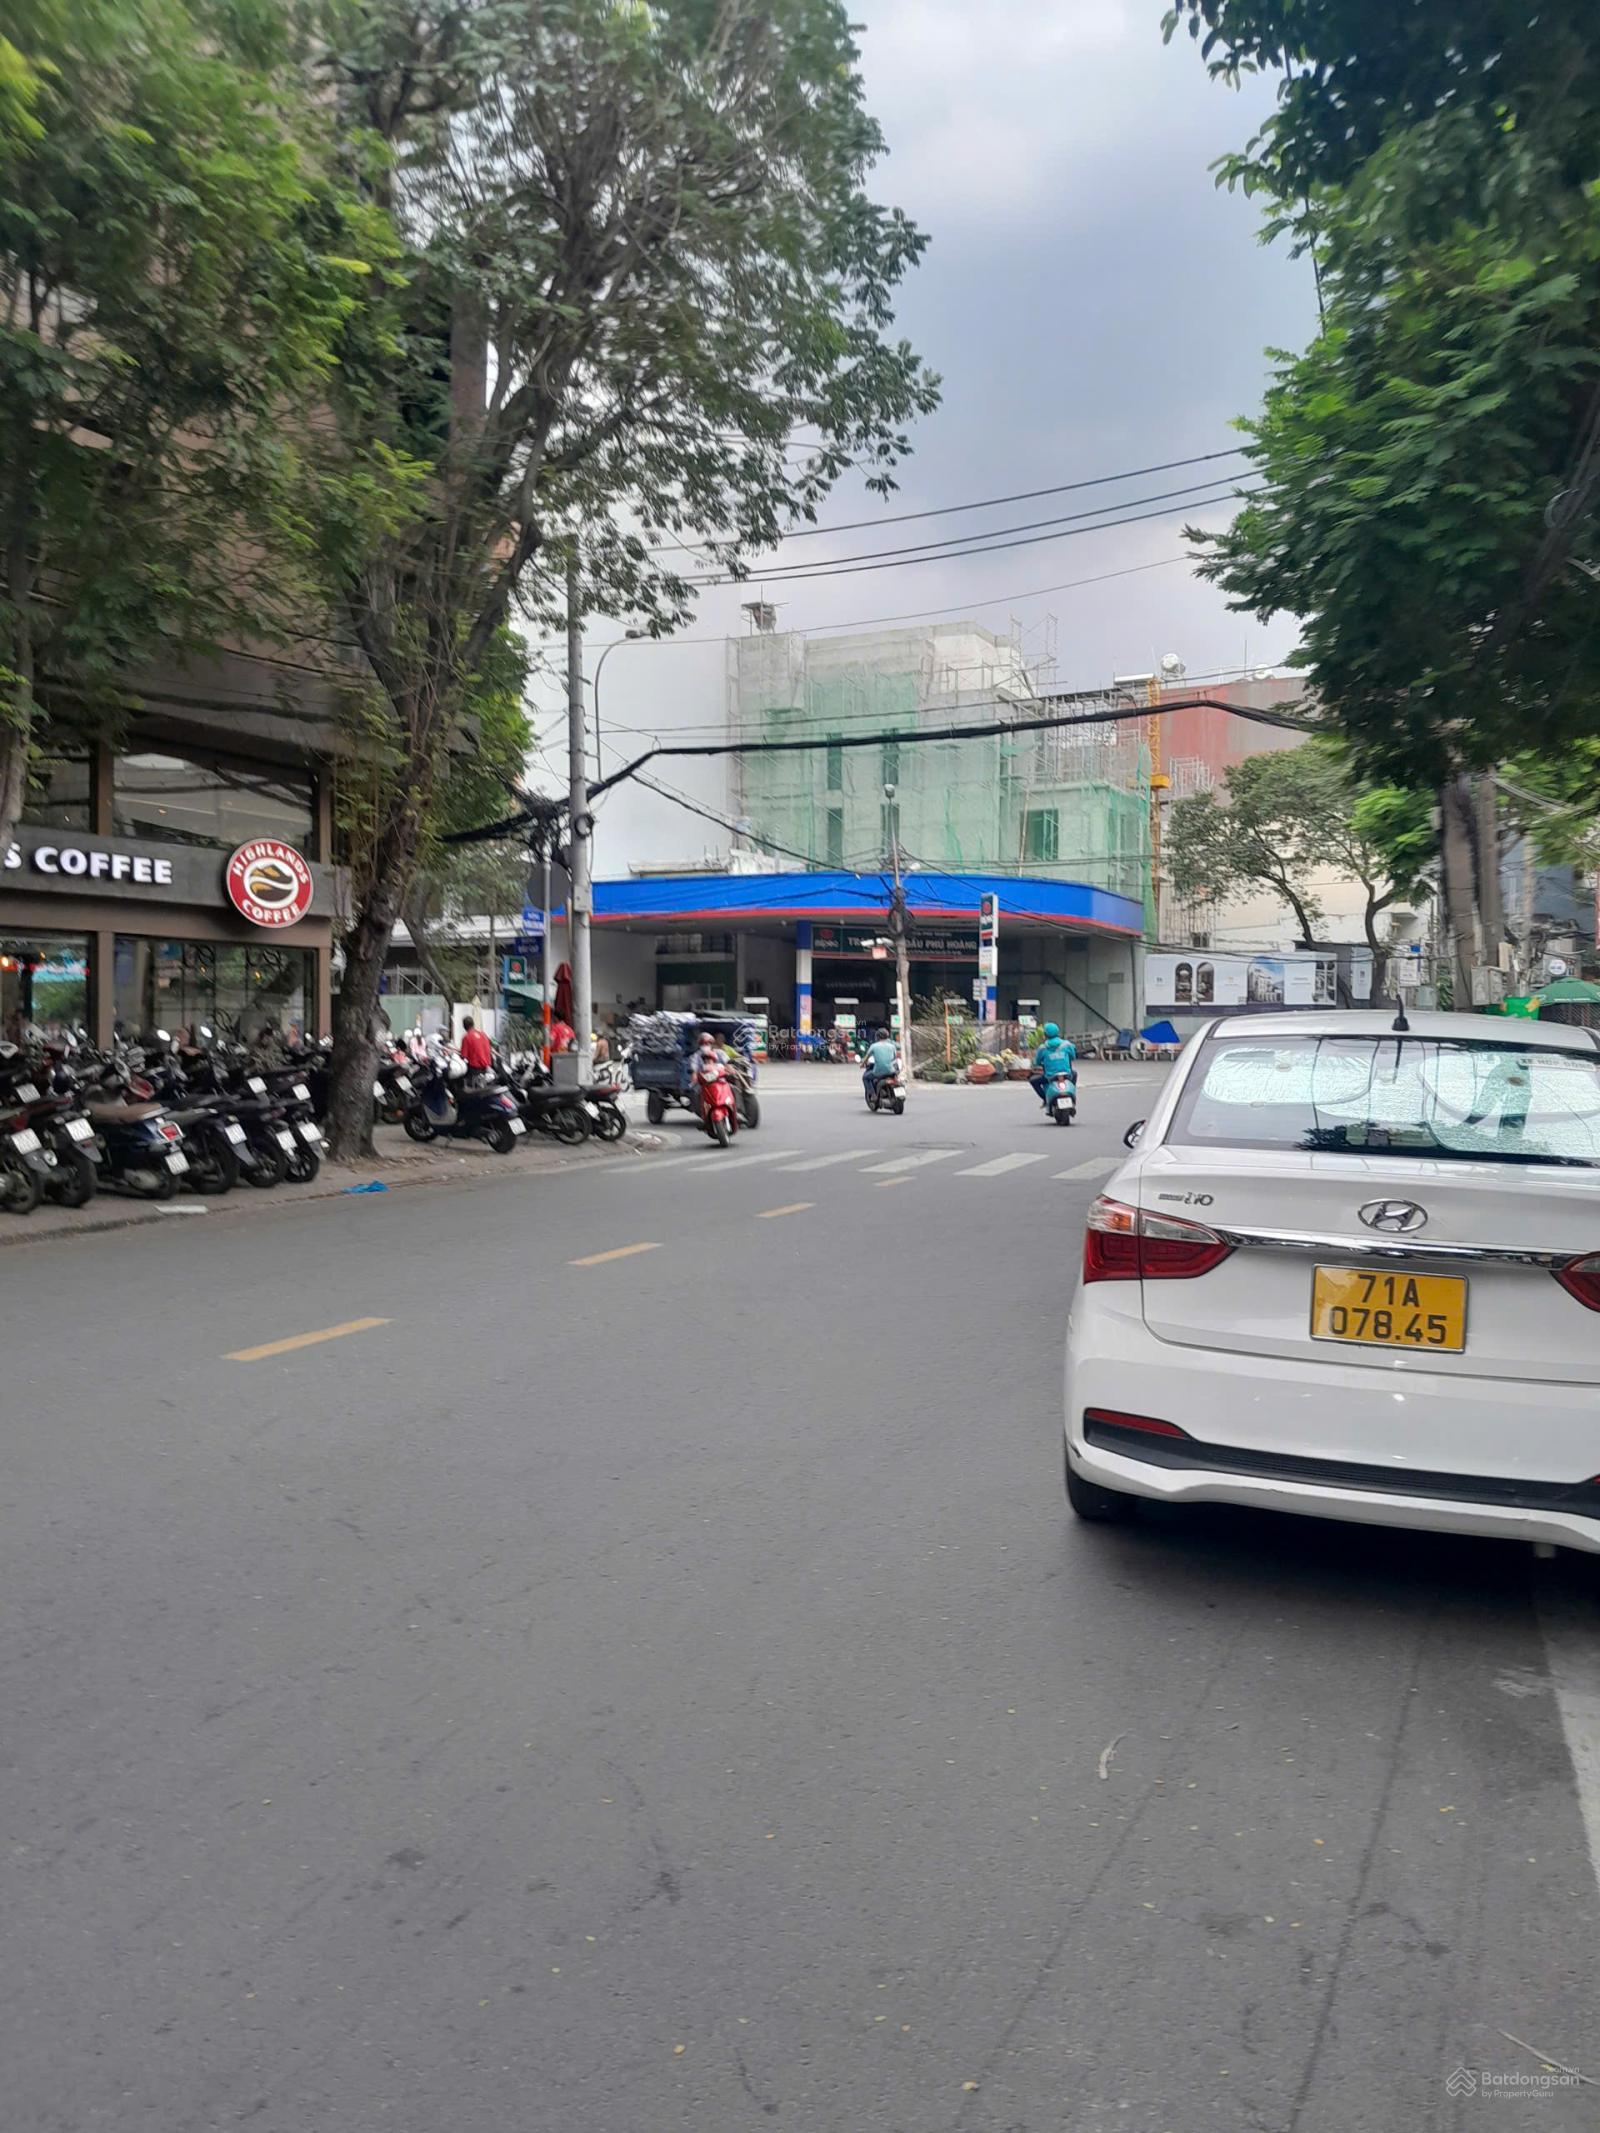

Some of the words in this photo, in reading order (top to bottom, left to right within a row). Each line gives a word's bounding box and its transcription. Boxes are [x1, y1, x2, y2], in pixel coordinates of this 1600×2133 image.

[34, 846, 173, 884] COFFEE
[233, 843, 309, 884] HIGHLANDS
[242, 899, 300, 922] COFFEE
[1358, 1274, 1420, 1307] 71A
[1330, 1306, 1447, 1344] 078.45
